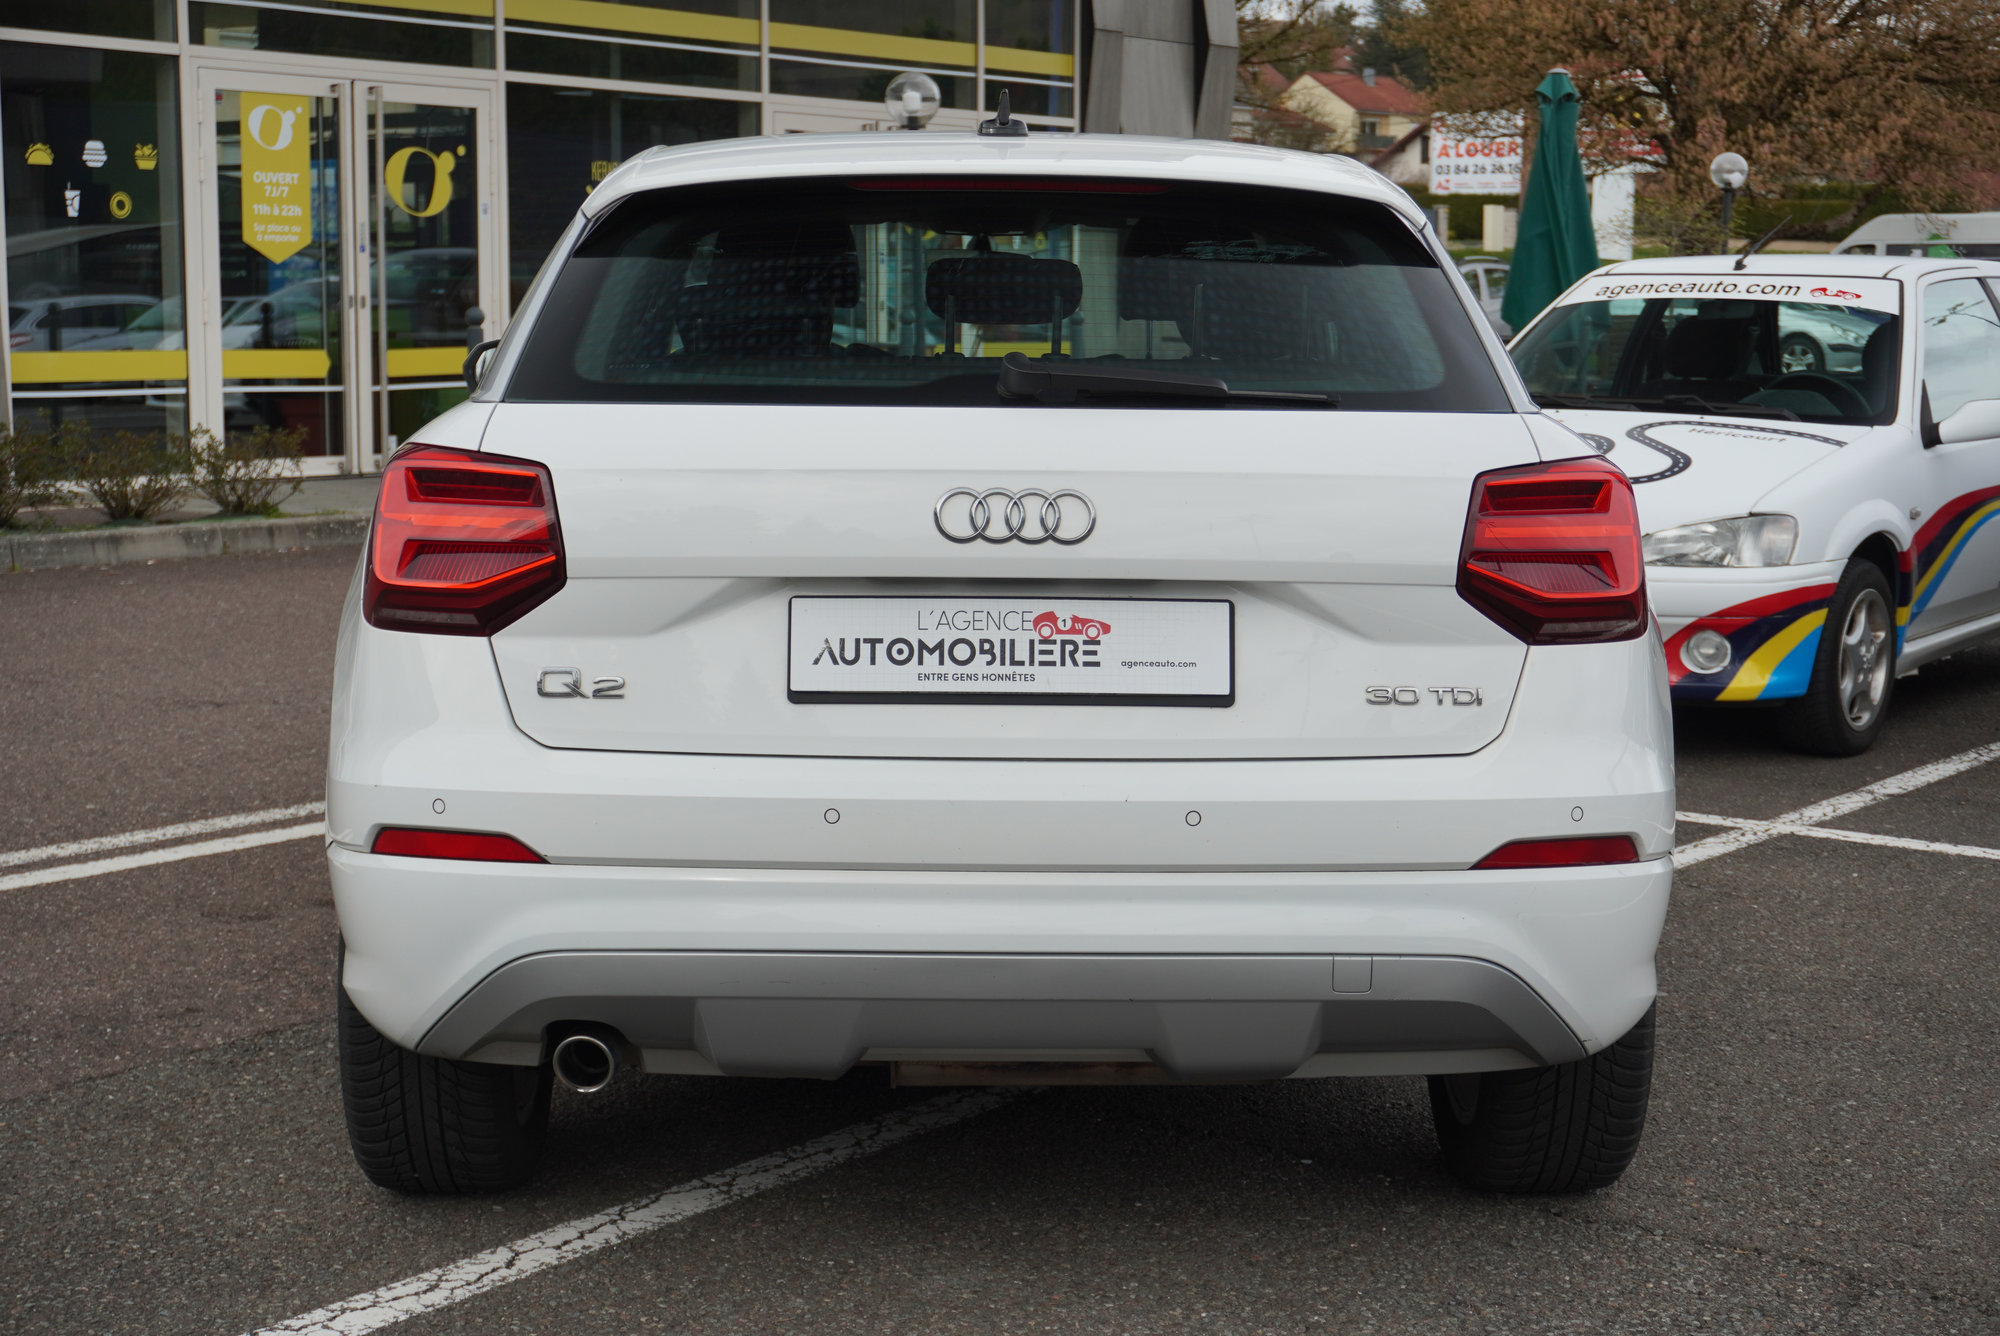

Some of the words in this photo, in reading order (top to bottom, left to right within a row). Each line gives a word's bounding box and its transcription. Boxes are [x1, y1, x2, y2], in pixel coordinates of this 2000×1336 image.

[1455, 141, 1520, 158] LOUER
[253, 171, 299, 184] OUVERT
[253, 203, 270, 215] 11h
[273, 203, 280, 216] à
[281, 204, 302, 216] 22h
[253, 222, 265, 232] Sur
[267, 223, 289, 233] place
[264, 233, 299, 243] emporter
[1595, 280, 1800, 298] agenceauto.com
[1688, 427, 1788, 443] Héricourt
[917, 610, 1033, 631] L'AGENCE
[1120, 659, 1197, 669] agenceauto.com
[917, 672, 949, 682] ENTRE
[952, 672, 979, 682] GENS
[981, 671, 1035, 682] HONNÊTES
[1365, 685, 1420, 706] 30
[1428, 686, 1483, 706] TDI
